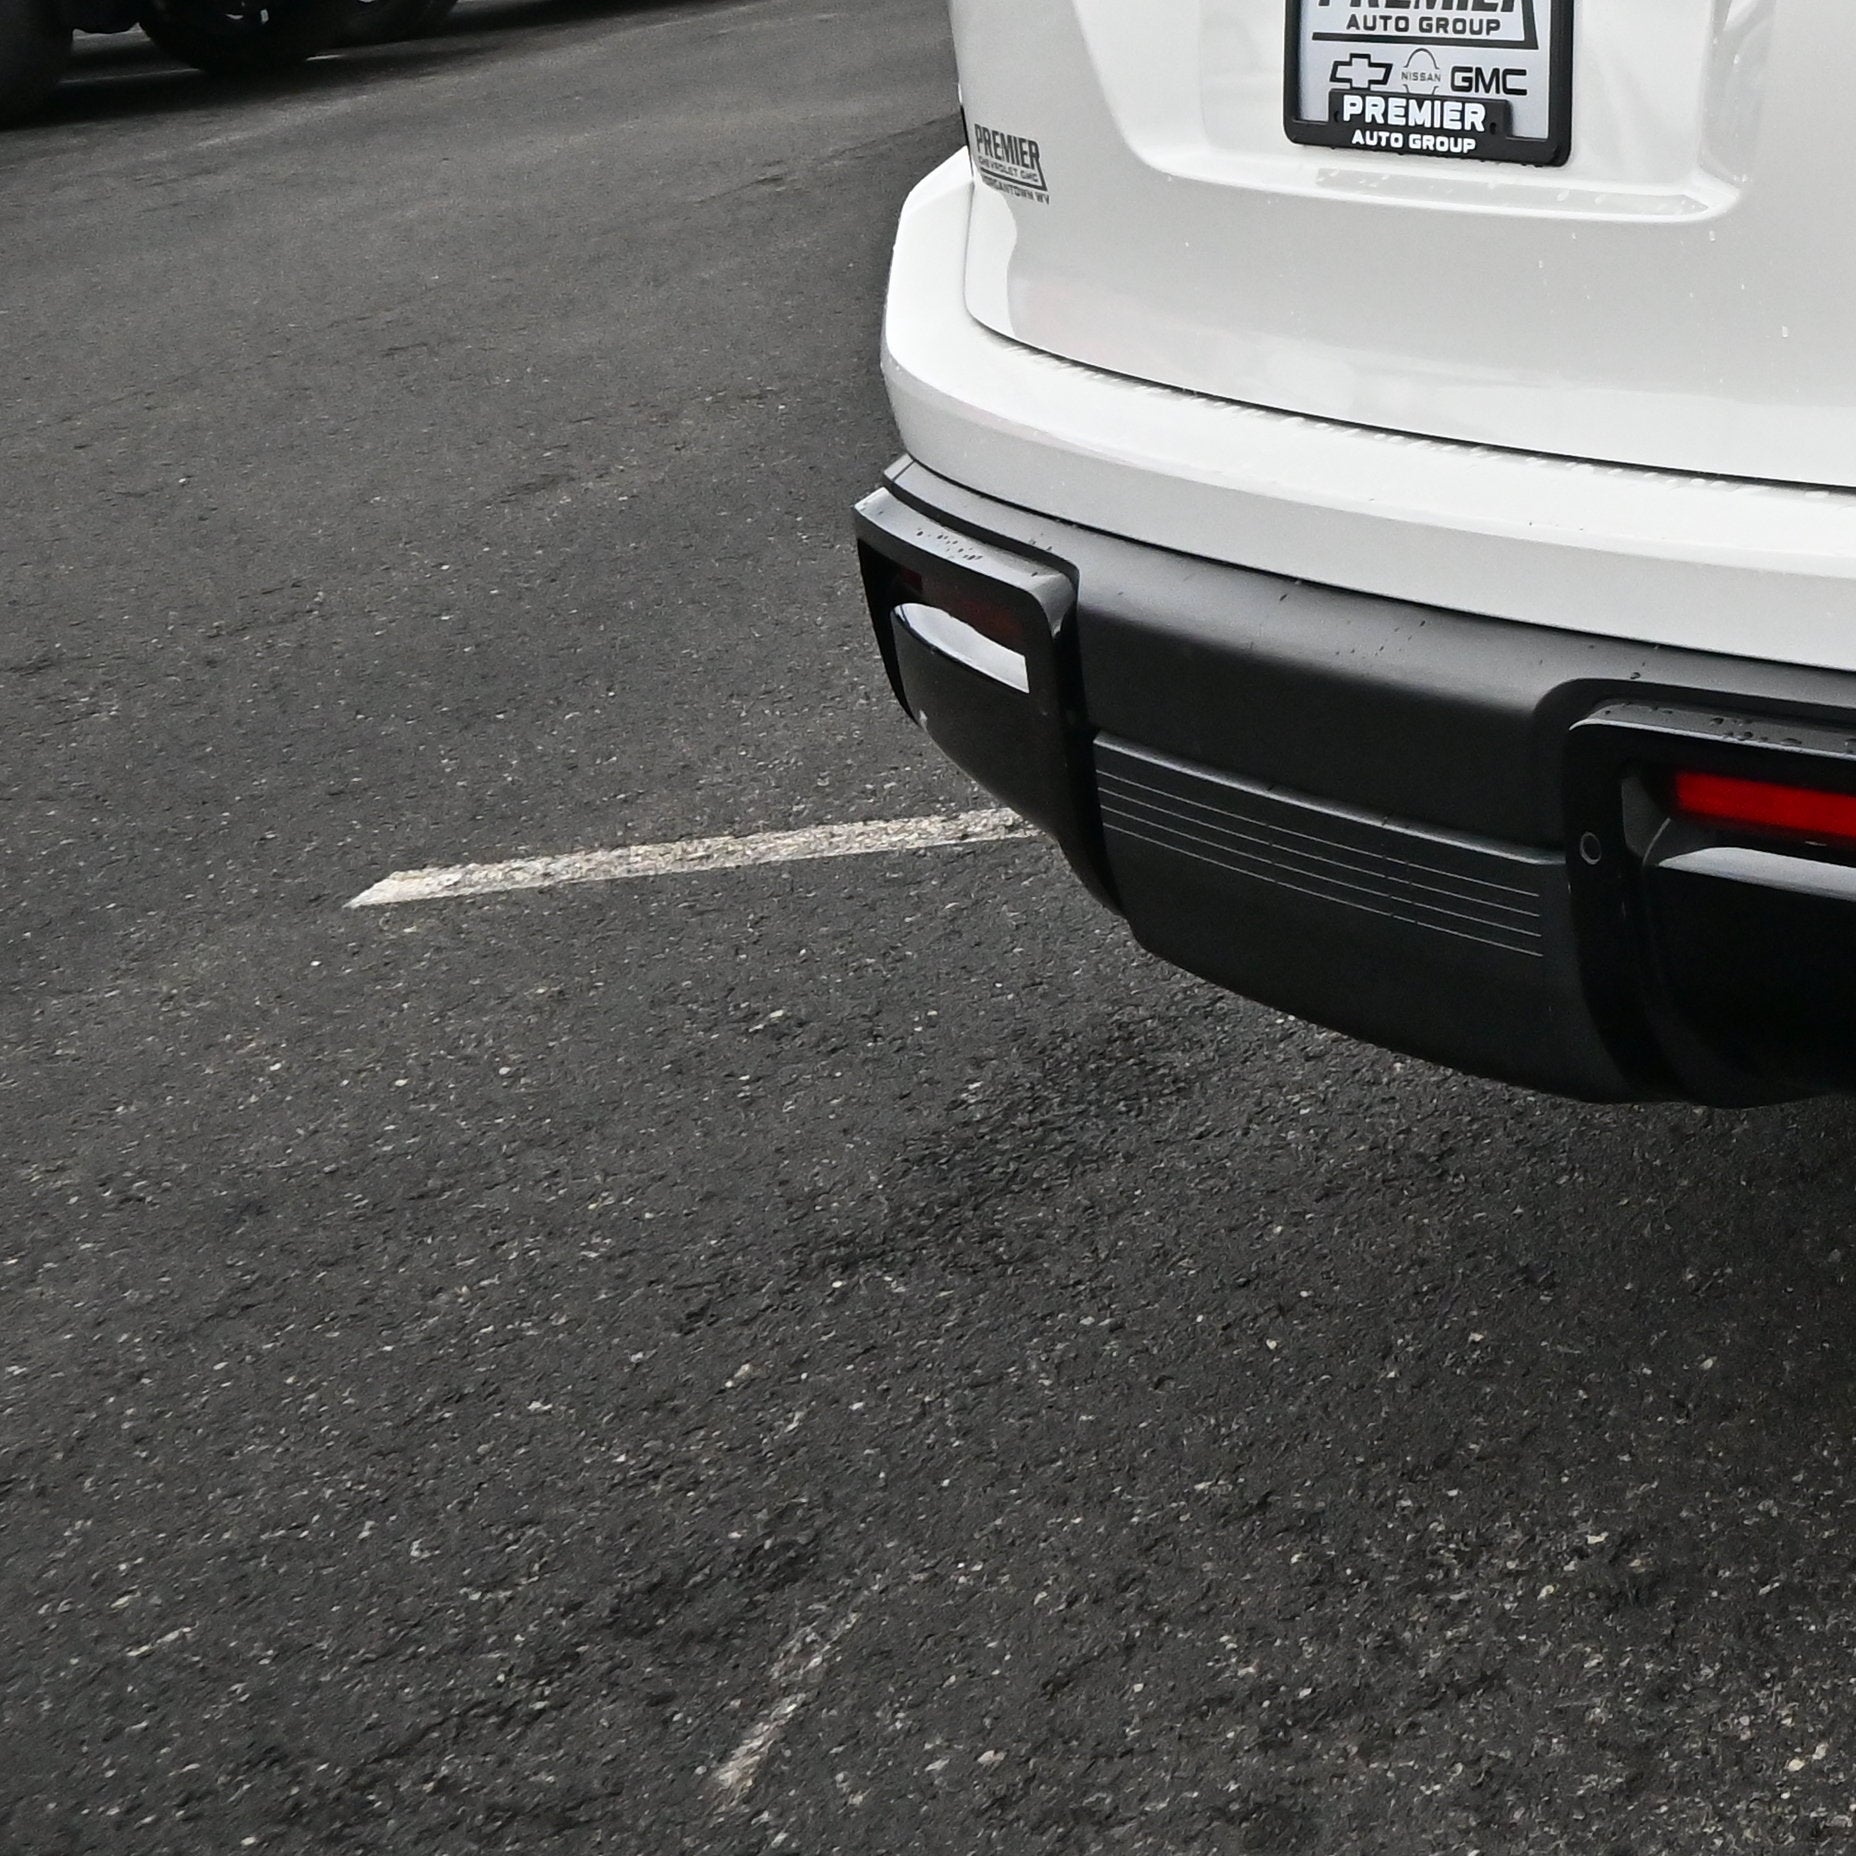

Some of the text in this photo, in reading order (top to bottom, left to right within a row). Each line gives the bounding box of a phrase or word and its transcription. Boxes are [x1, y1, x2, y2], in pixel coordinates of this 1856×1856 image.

[1346, 14, 1501, 36] AUTO GROUP
[1401, 66, 1528, 95] NISSAN GMC
[1343, 95, 1486, 132] PREMIER
[974, 124, 1041, 171] PREMIER
[1352, 129, 1476, 153] AUTO GROUP
